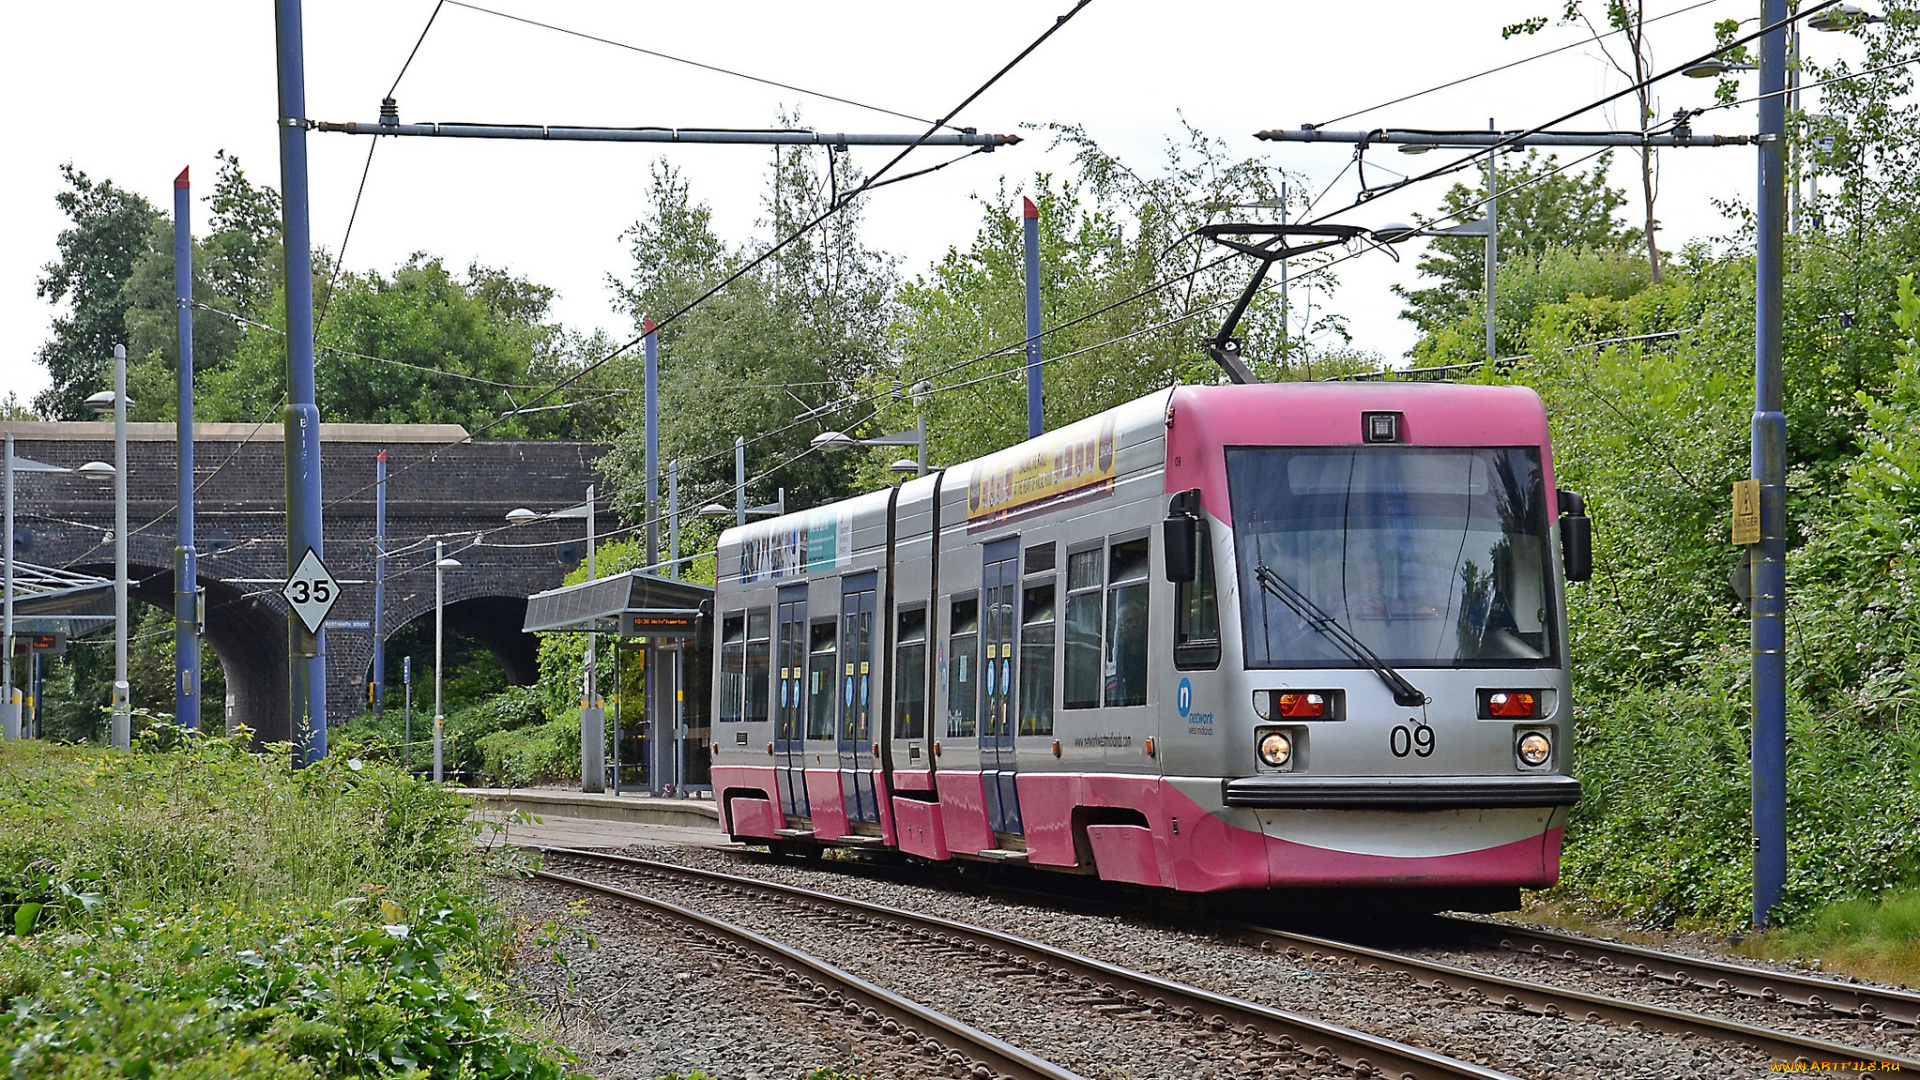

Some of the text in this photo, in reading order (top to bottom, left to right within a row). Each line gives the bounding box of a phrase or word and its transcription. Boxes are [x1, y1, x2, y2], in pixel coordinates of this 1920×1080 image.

[1175, 456, 1181, 467] 09
[1734, 516, 1759, 528] DANGER
[292, 580, 330, 604] 35
[1189, 712, 1214, 724] network
[1074, 731, 1132, 748] www.networkwestmidlands.com
[1390, 725, 1435, 757] 09
